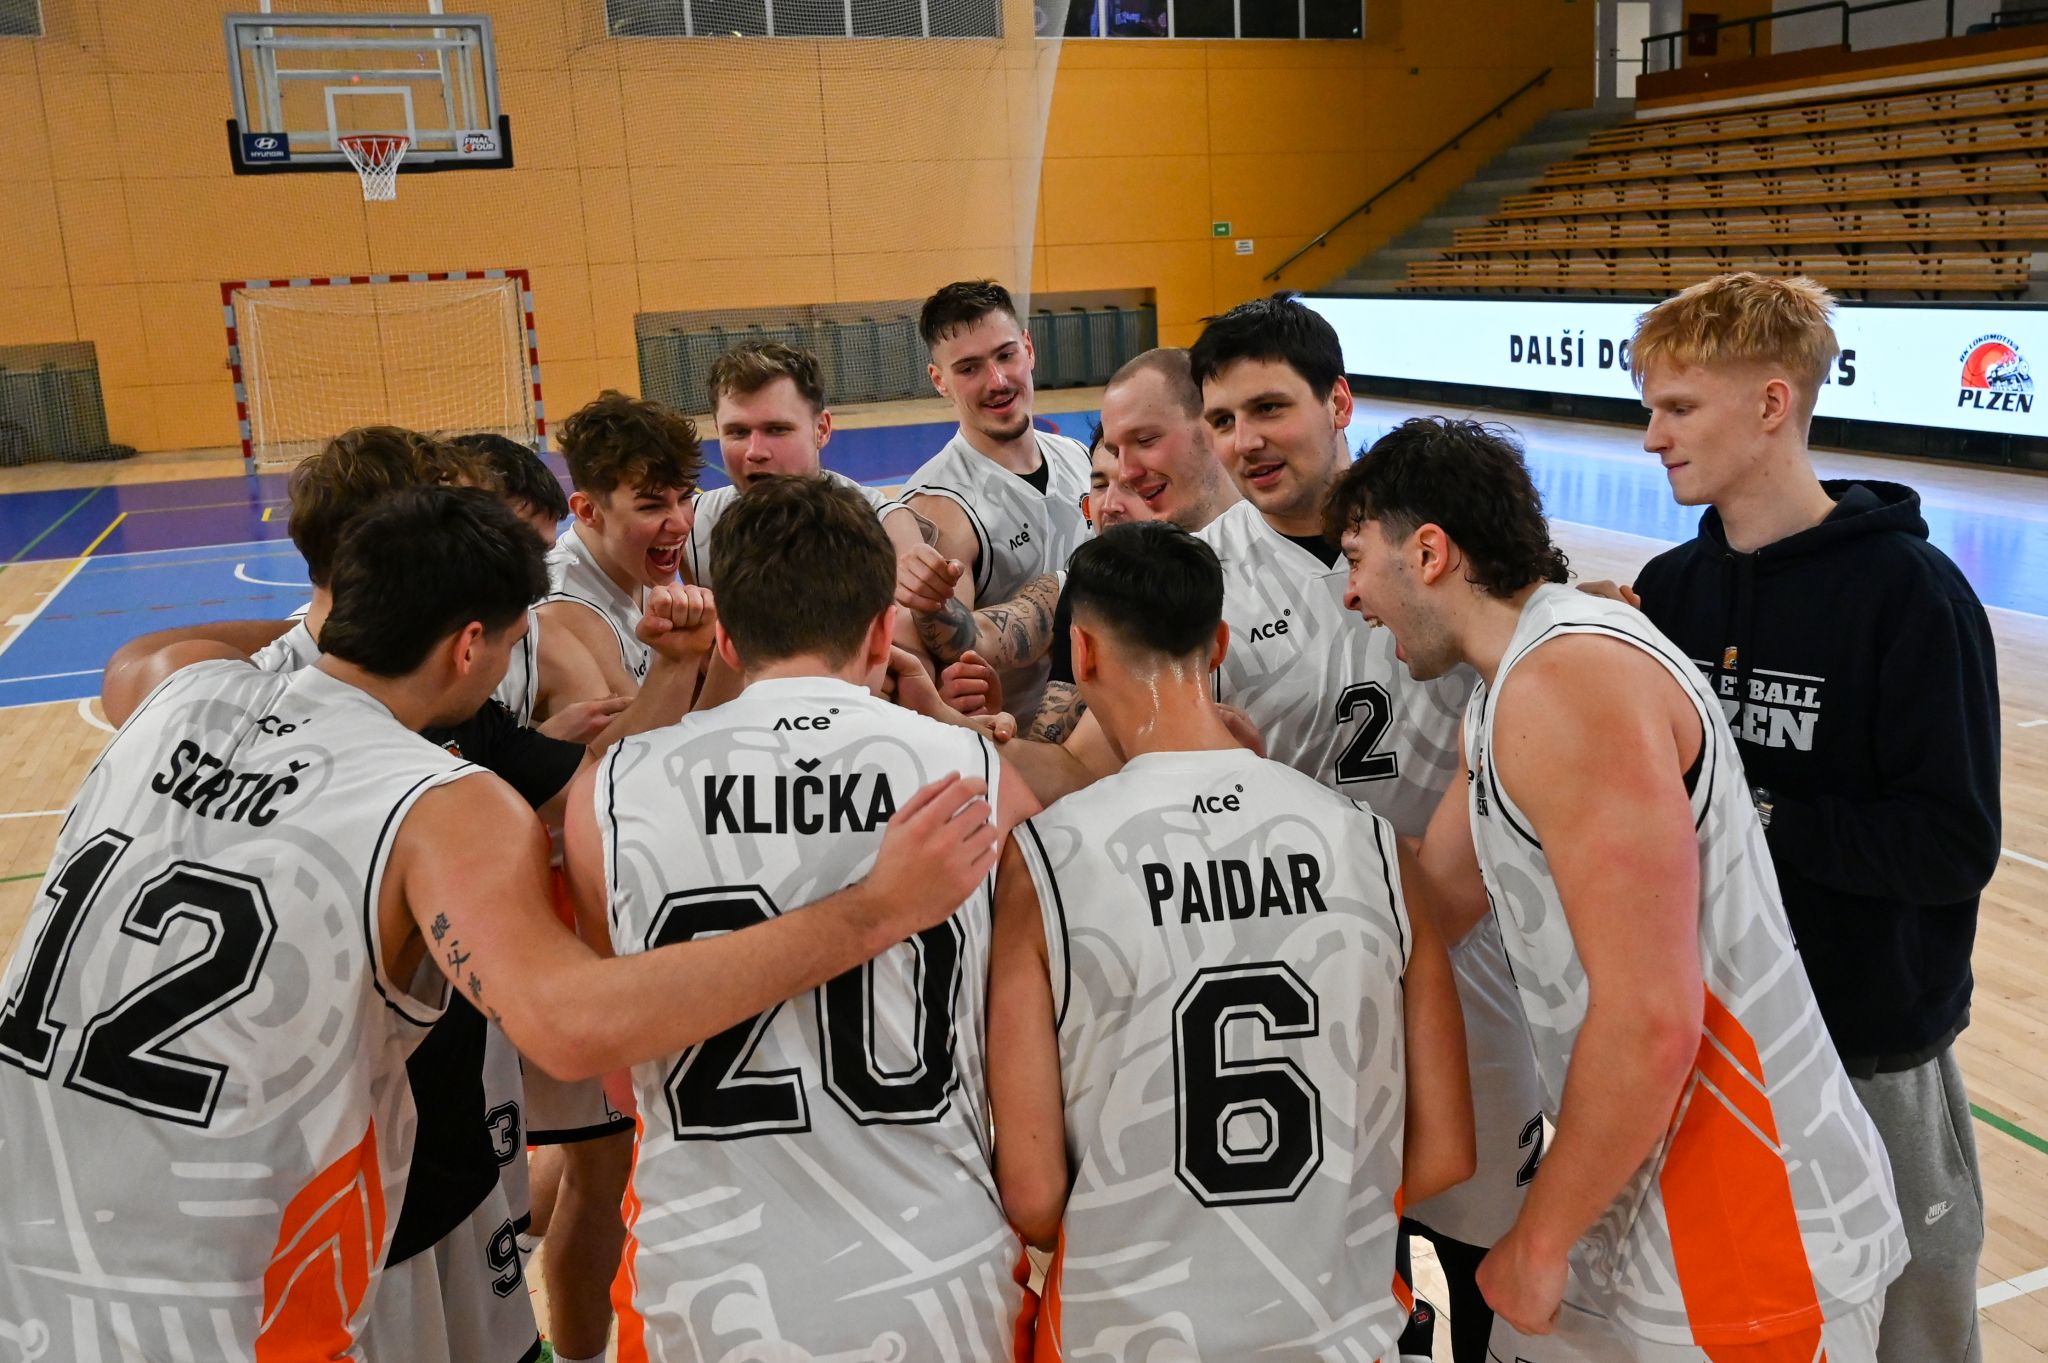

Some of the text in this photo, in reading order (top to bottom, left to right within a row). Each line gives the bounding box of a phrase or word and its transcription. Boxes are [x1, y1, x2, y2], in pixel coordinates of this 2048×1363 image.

[465, 136, 488, 144] FINAL
[1510, 328, 1584, 368] DALŠÍ
[1599, 338, 1631, 371] DO
[1957, 389, 2034, 413] PLZEN
[1335, 680, 1399, 785] 2
[1718, 699, 1819, 751] ZEN
[704, 757, 898, 836] KLIČKA
[1142, 852, 1328, 927] PAIDAR
[0, 827, 279, 1129] 12
[644, 884, 967, 1141] 20
[1172, 960, 1324, 1209] 6
[484, 1099, 521, 1168] 3
[1516, 1110, 1545, 1188] 2
[1928, 1200, 1947, 1217] NIKE
[485, 1218, 523, 1299] 9
